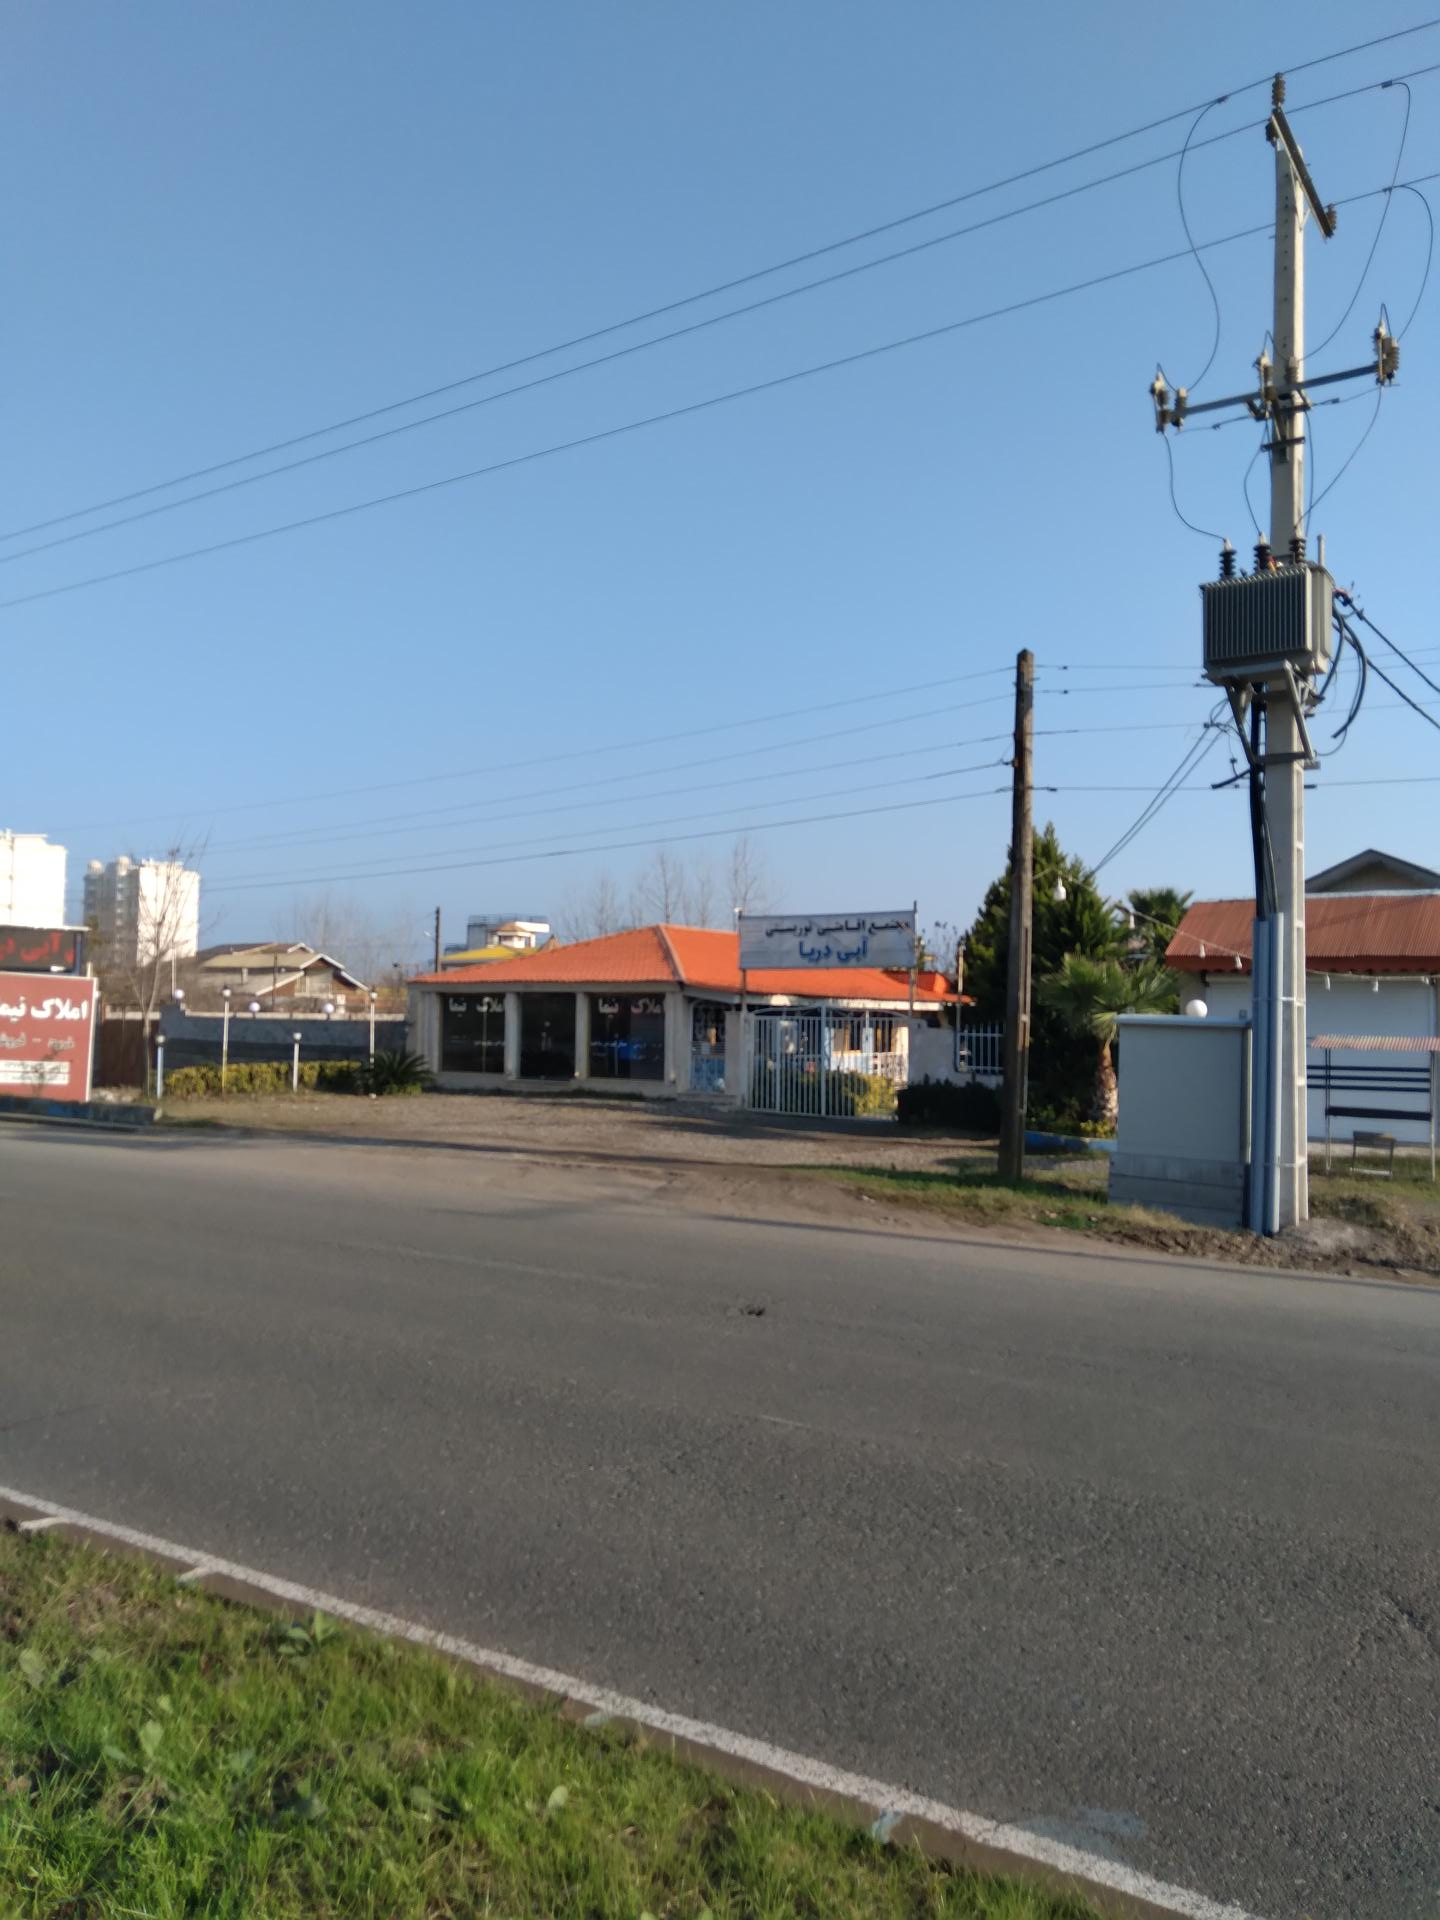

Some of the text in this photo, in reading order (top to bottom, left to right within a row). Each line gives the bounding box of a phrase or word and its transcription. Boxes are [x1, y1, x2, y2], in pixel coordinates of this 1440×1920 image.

[817, 918, 866, 936] اقامتی
[799, 940, 833, 965] دریا
[0, 996, 88, 1023] املاک نیم
[476, 997, 505, 1014] ملاک
[631, 997, 664, 1013] ملاک
